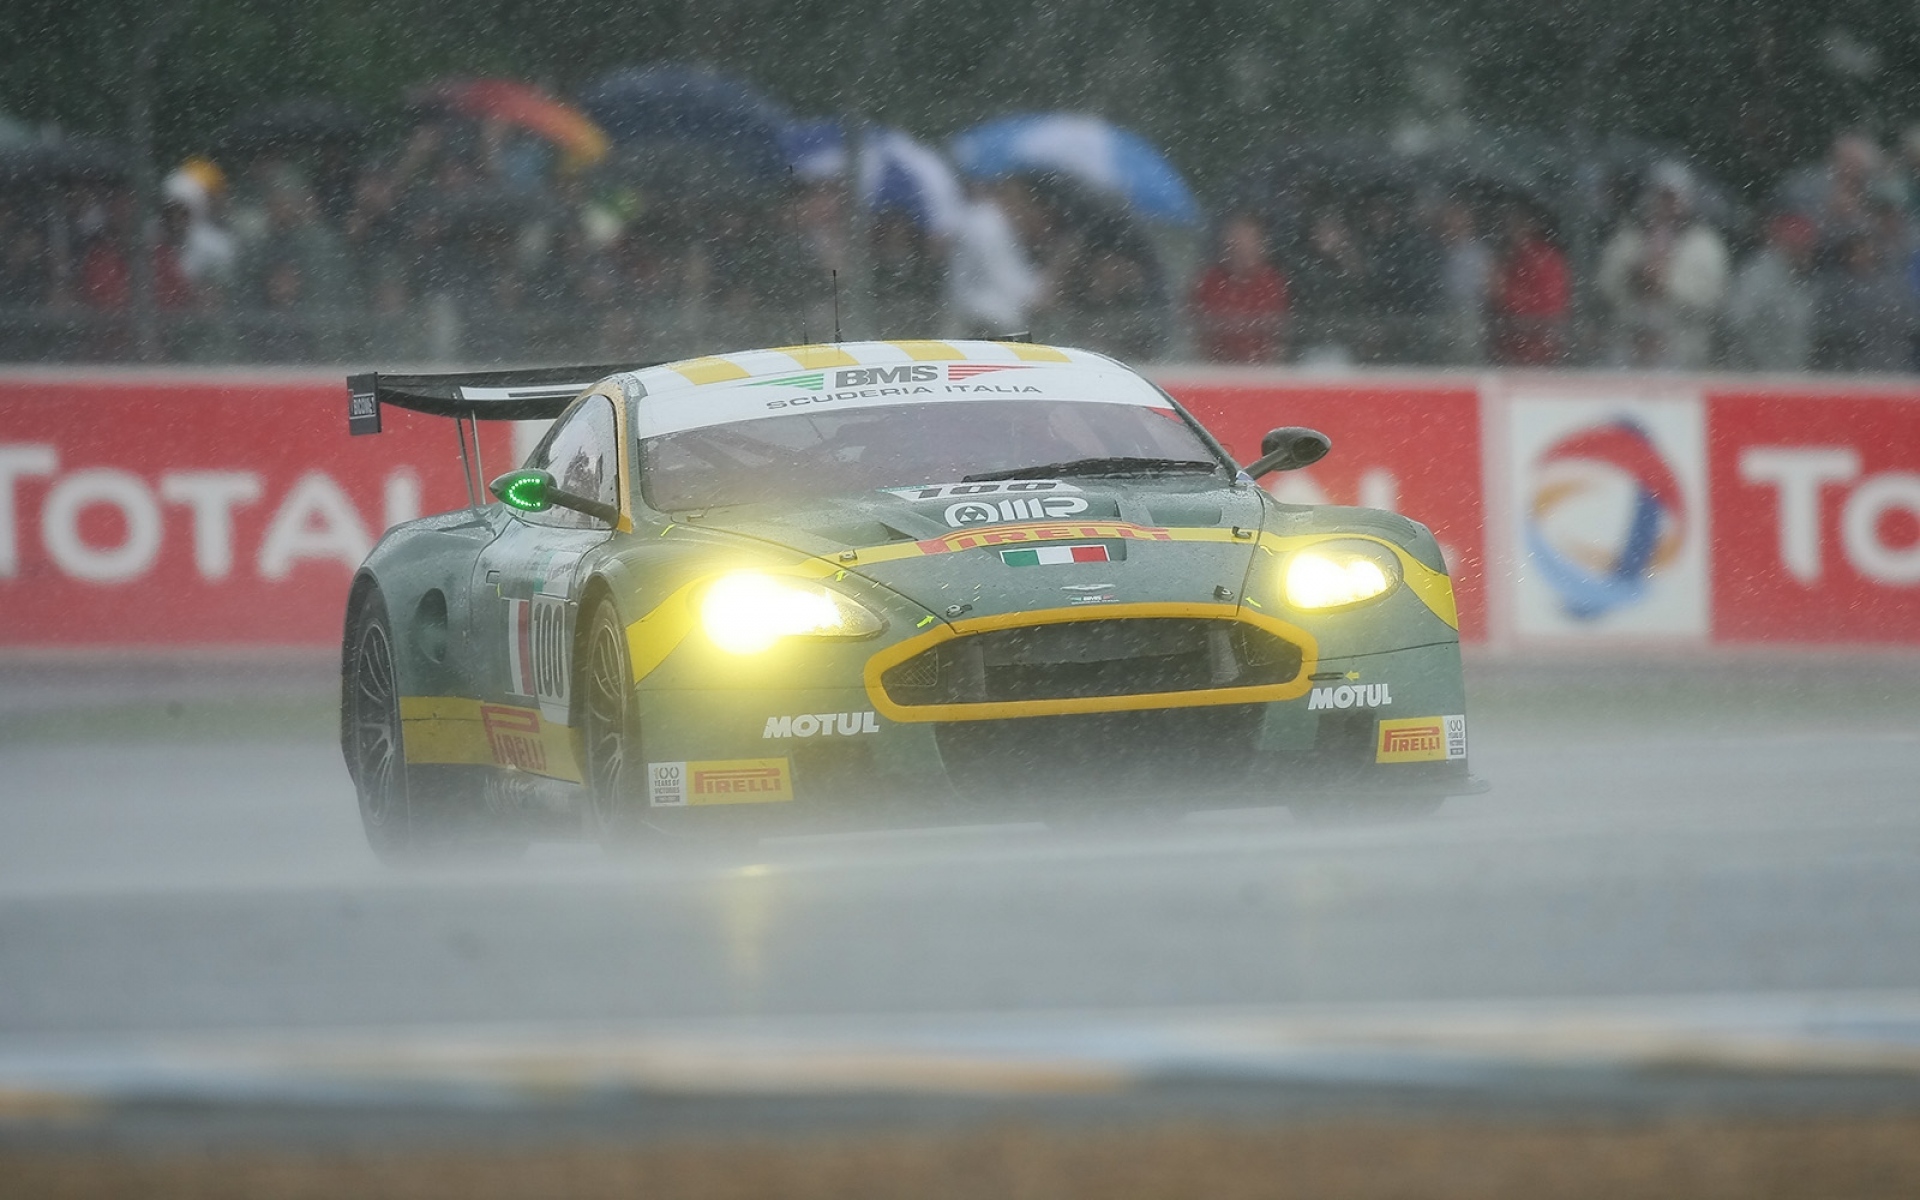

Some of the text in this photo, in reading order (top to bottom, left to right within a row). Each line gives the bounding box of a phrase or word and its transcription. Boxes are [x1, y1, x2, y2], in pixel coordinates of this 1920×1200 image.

[835, 365, 939, 388] BMS
[766, 384, 1043, 410] SCUDERIA ITALIA
[916, 521, 1173, 555] PIRELLI
[534, 602, 565, 699] 100
[1307, 683, 1392, 710] MOTUL
[762, 711, 880, 739] MOTUL
[1383, 726, 1441, 752] PIRELLI
[653, 767, 680, 780] 100
[694, 768, 782, 794] PIRELLI
